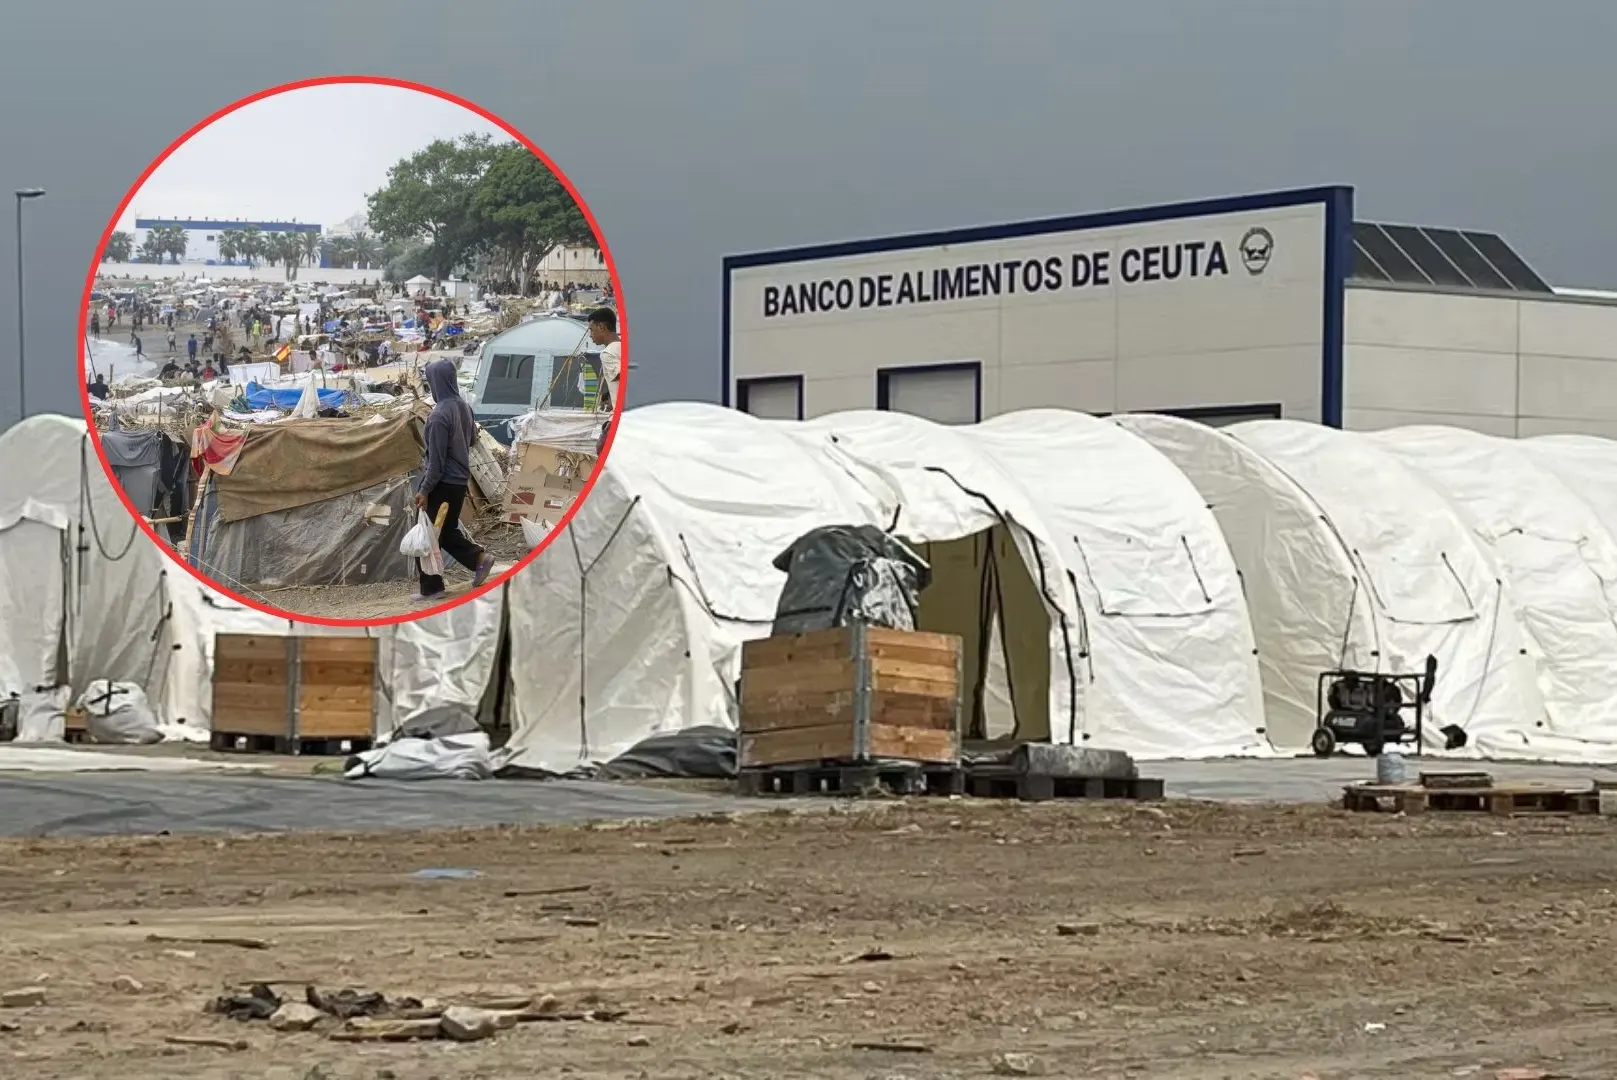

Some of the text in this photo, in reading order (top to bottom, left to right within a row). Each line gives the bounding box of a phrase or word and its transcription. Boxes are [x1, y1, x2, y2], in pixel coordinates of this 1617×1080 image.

[764, 278, 854, 317] BANCO
[859, 274, 893, 309] DE
[896, 256, 1062, 305] ALIMENTOS
[1071, 251, 1110, 288] DE
[1120, 240, 1229, 283] CEUTA
